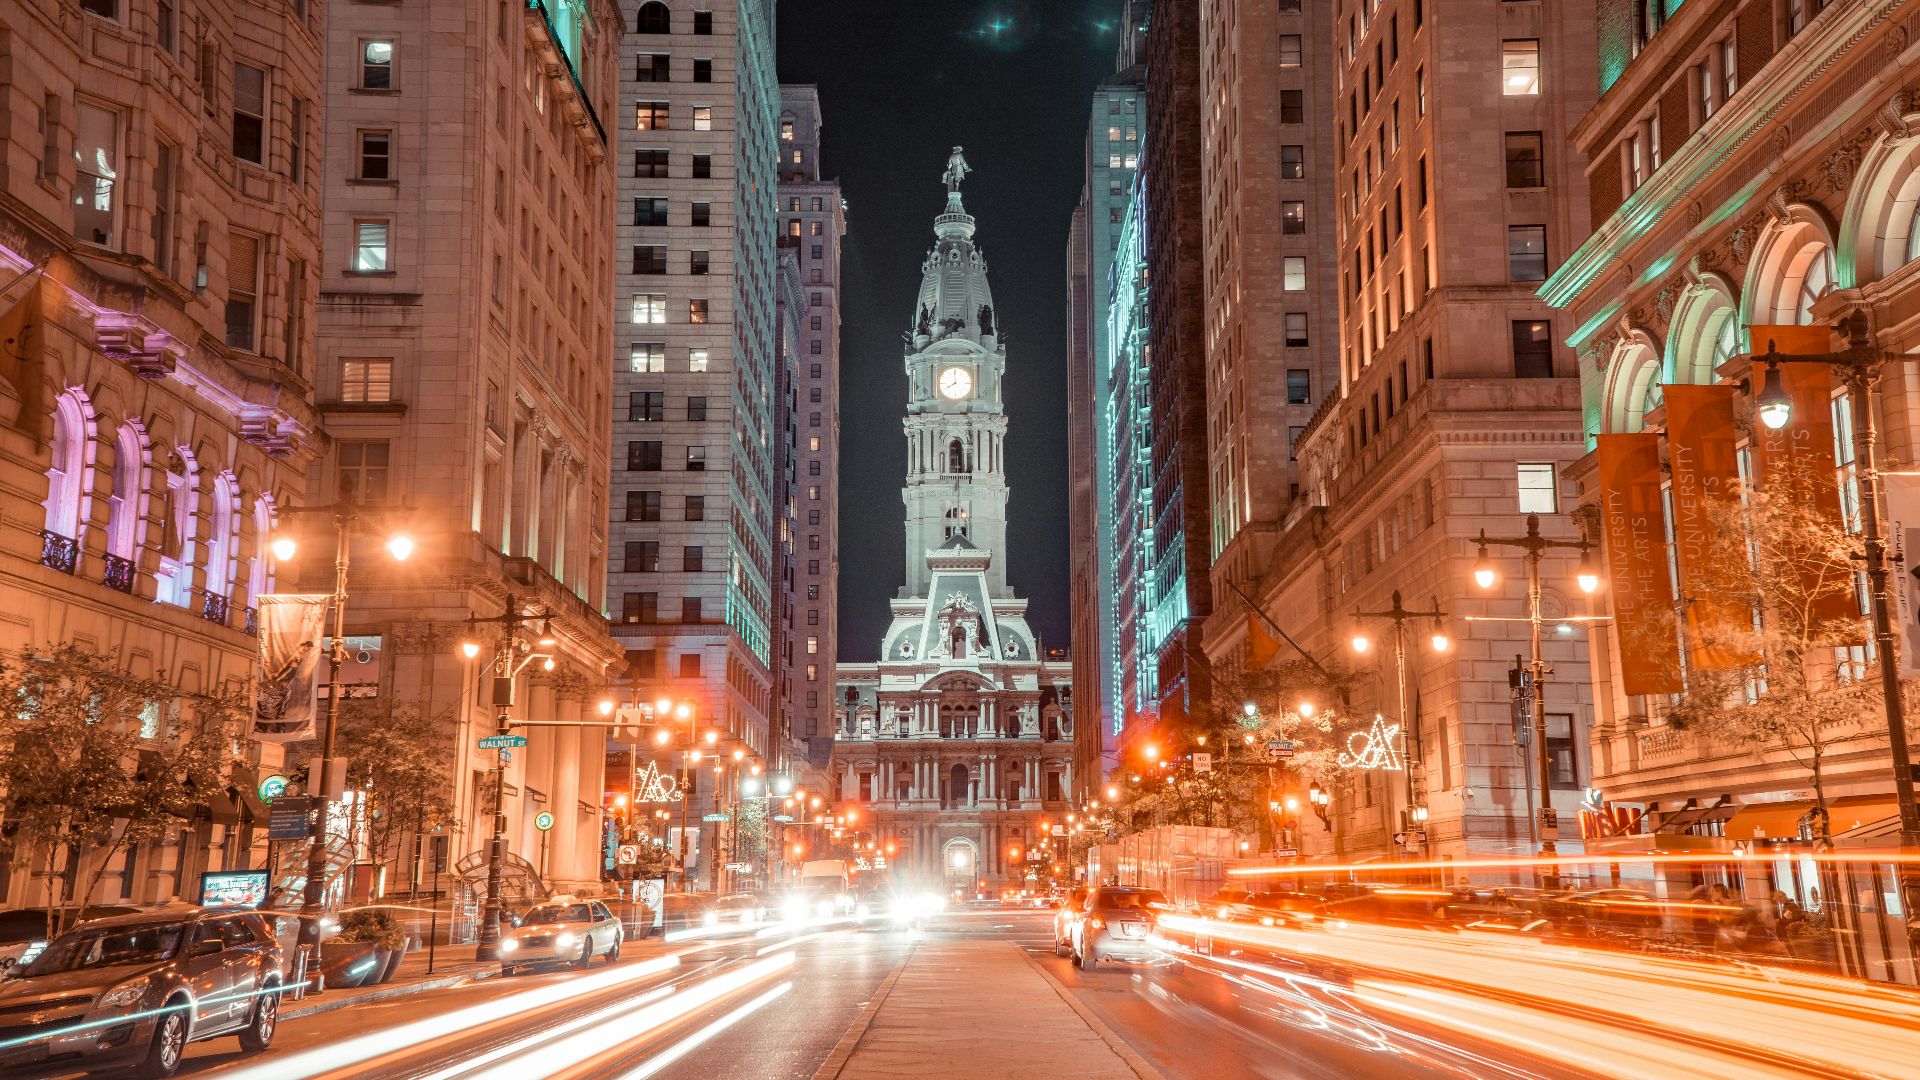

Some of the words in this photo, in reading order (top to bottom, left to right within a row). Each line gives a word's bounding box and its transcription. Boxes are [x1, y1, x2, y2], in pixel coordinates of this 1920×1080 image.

[1676, 443, 1703, 558] UNIVERSITY
[1607, 488, 1632, 593] UNIVERSITY
[1631, 516, 1651, 563] ARTS
[1637, 565, 1657, 605] THE
[1618, 600, 1636, 633] THE
[479, 739, 515, 748] WALNUT
